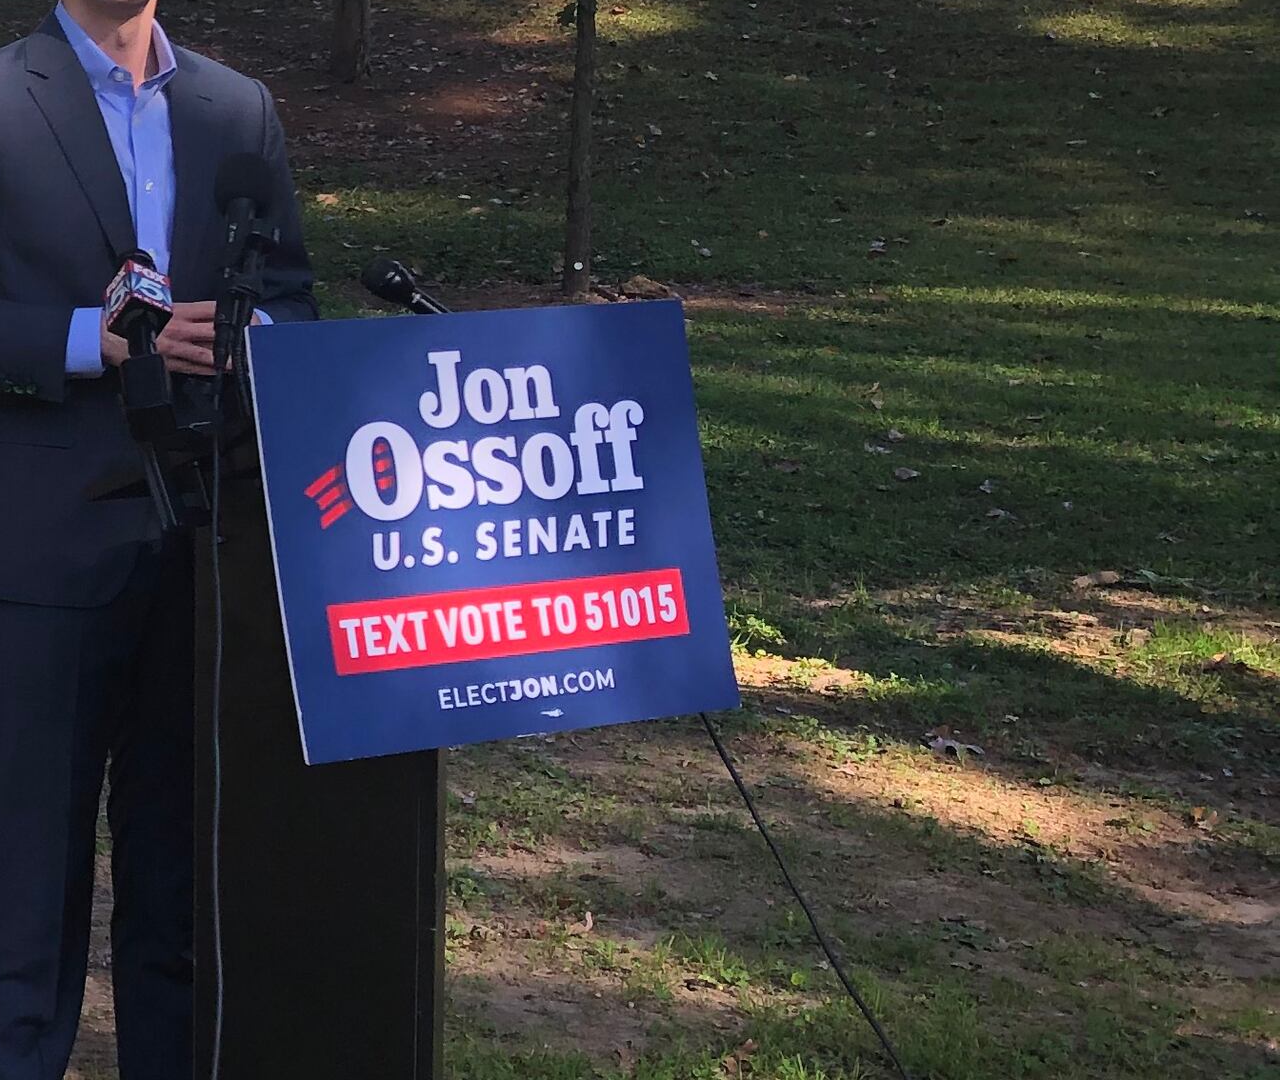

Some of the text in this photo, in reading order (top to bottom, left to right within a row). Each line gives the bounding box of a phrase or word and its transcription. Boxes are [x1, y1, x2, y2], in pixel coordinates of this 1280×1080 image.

[133, 263, 167, 285] FOX
[137, 276, 165, 301] 5
[418, 350, 560, 428] Jon
[345, 400, 644, 521] Ossoff
[372, 508, 636, 570] U.S. SENATE
[339, 584, 678, 659] TEXT VOTE TO 51015
[438, 668, 616, 710] ELECTJON.COM
